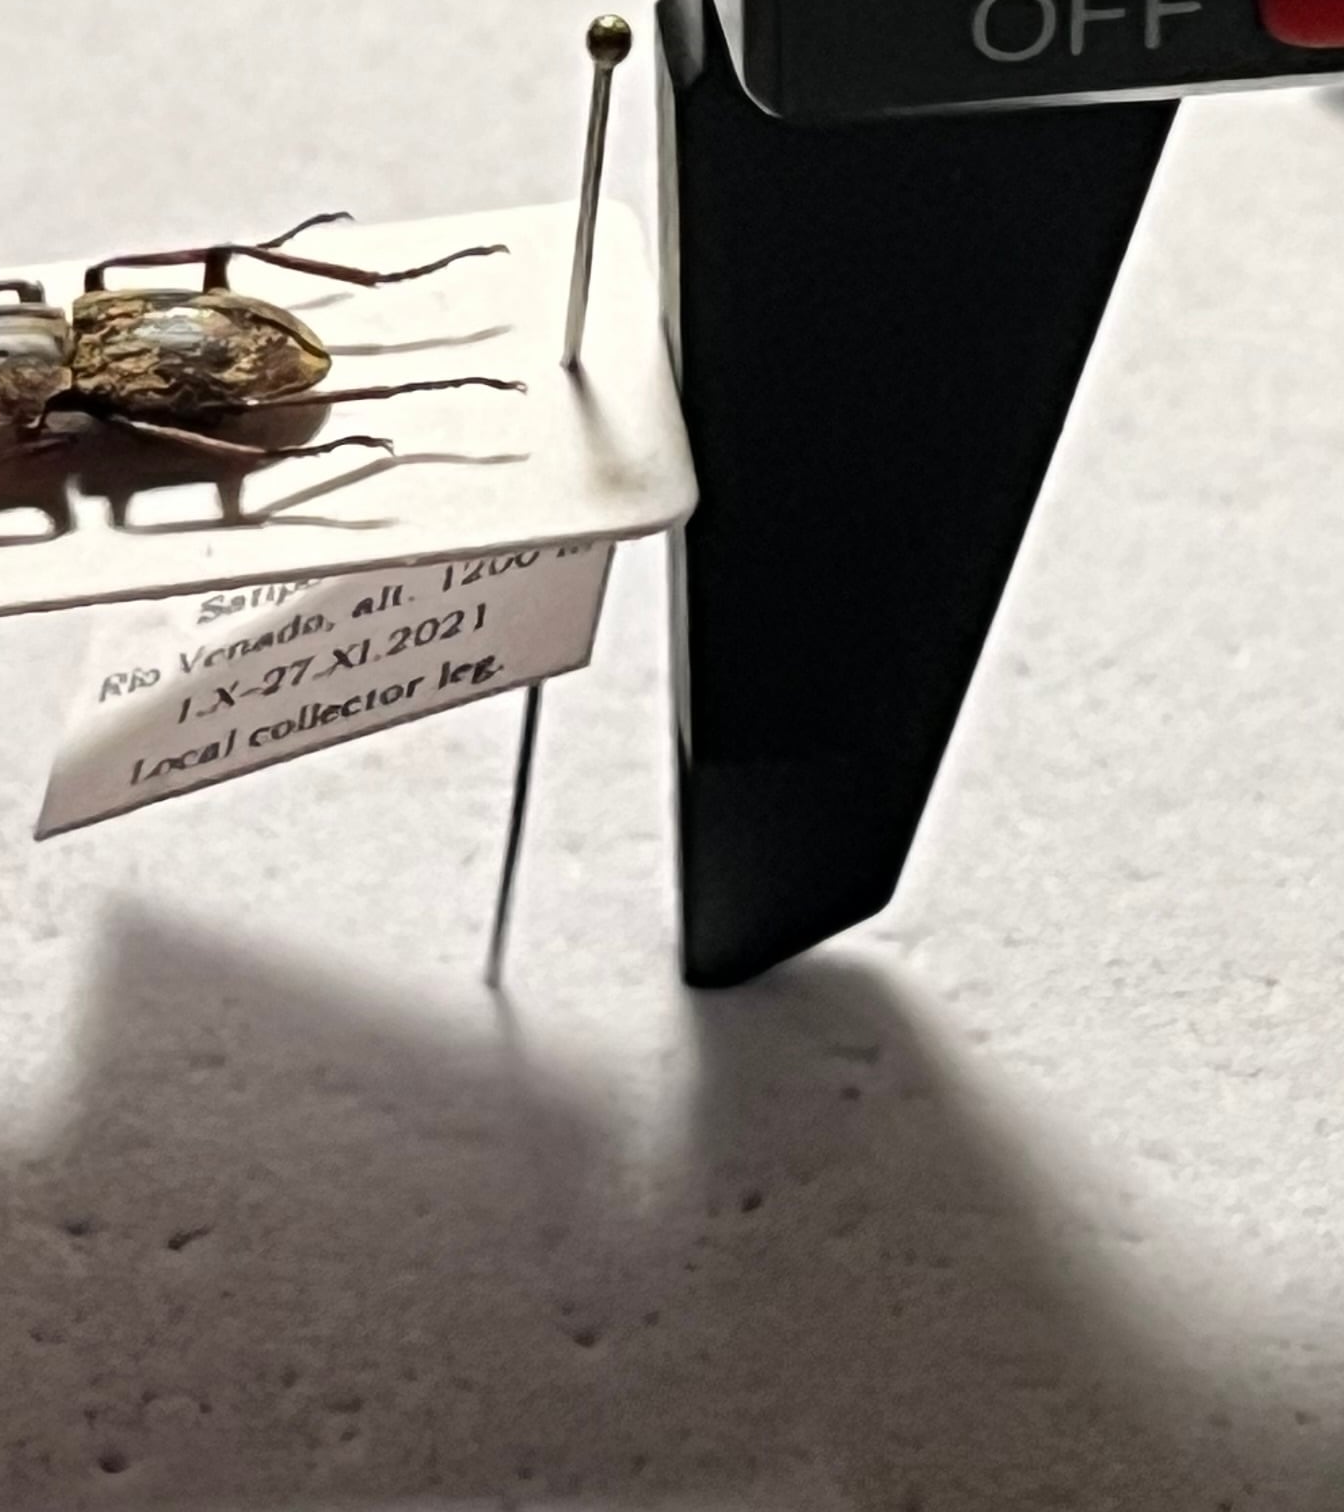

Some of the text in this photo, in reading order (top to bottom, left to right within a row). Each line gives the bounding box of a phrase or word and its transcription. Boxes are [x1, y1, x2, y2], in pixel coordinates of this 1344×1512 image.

[179, 614, 336, 674] Venado,
[129, 728, 238, 785] Local
[248, 676, 425, 748] collector
